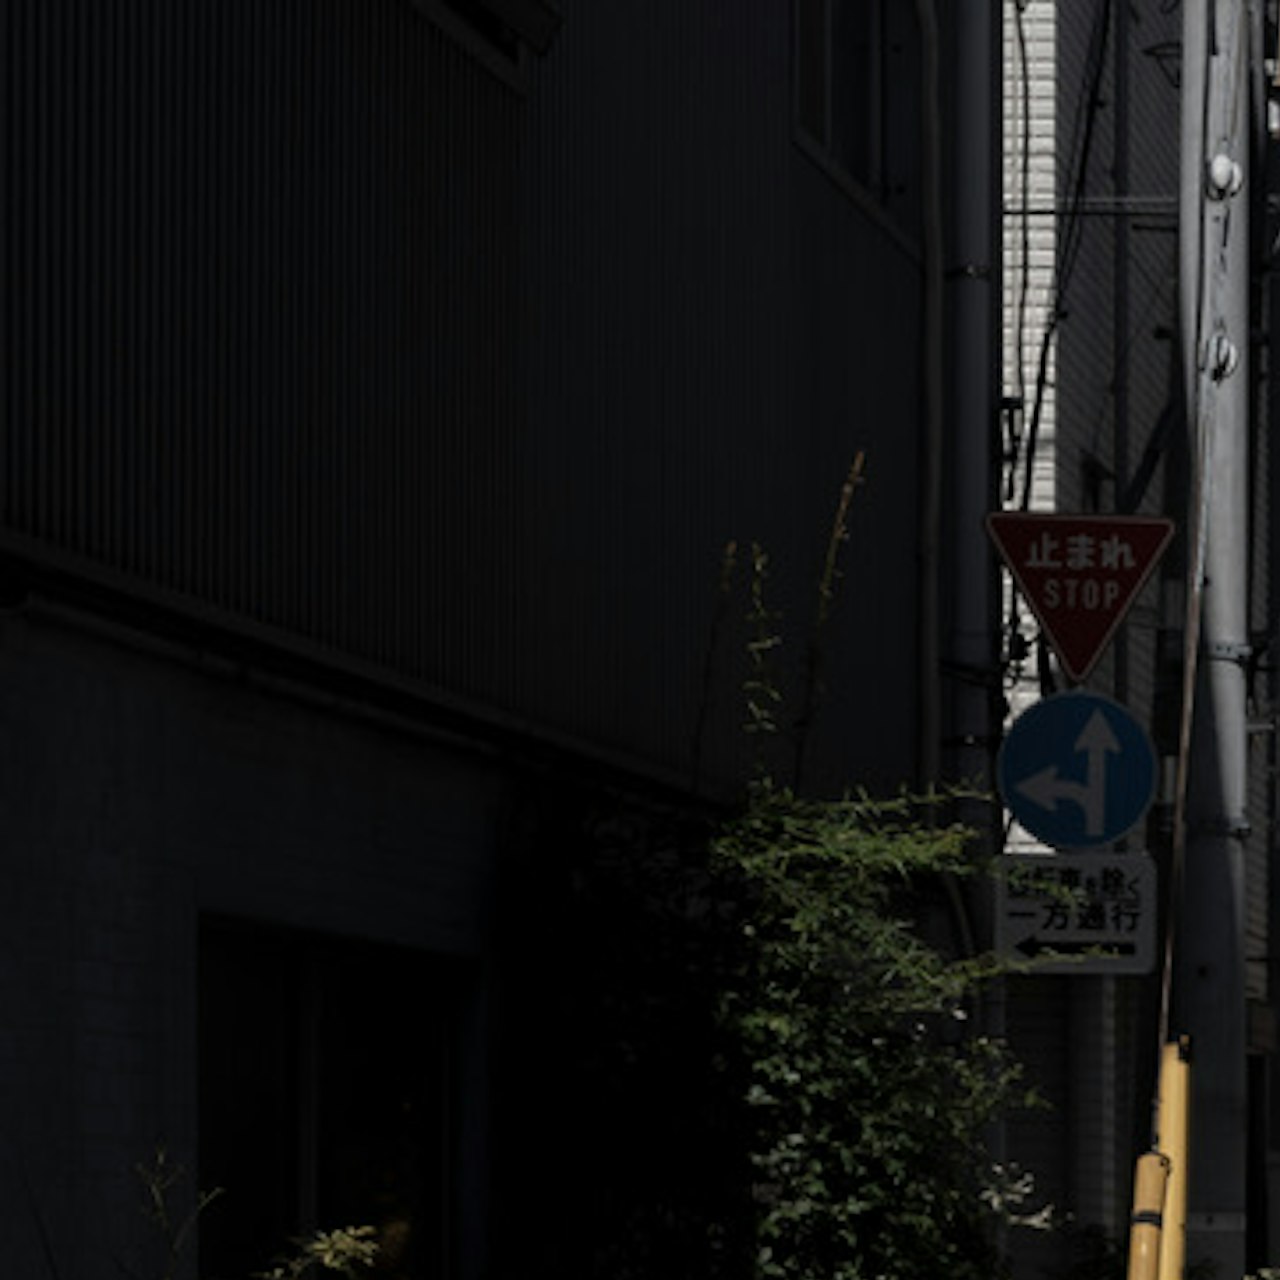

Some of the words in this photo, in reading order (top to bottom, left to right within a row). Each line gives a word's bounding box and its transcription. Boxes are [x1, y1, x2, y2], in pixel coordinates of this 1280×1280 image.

[1023, 531, 1137, 571] 止まれ
[1042, 578, 1122, 610] STOP
[1008, 901, 1141, 931] 一方通行
